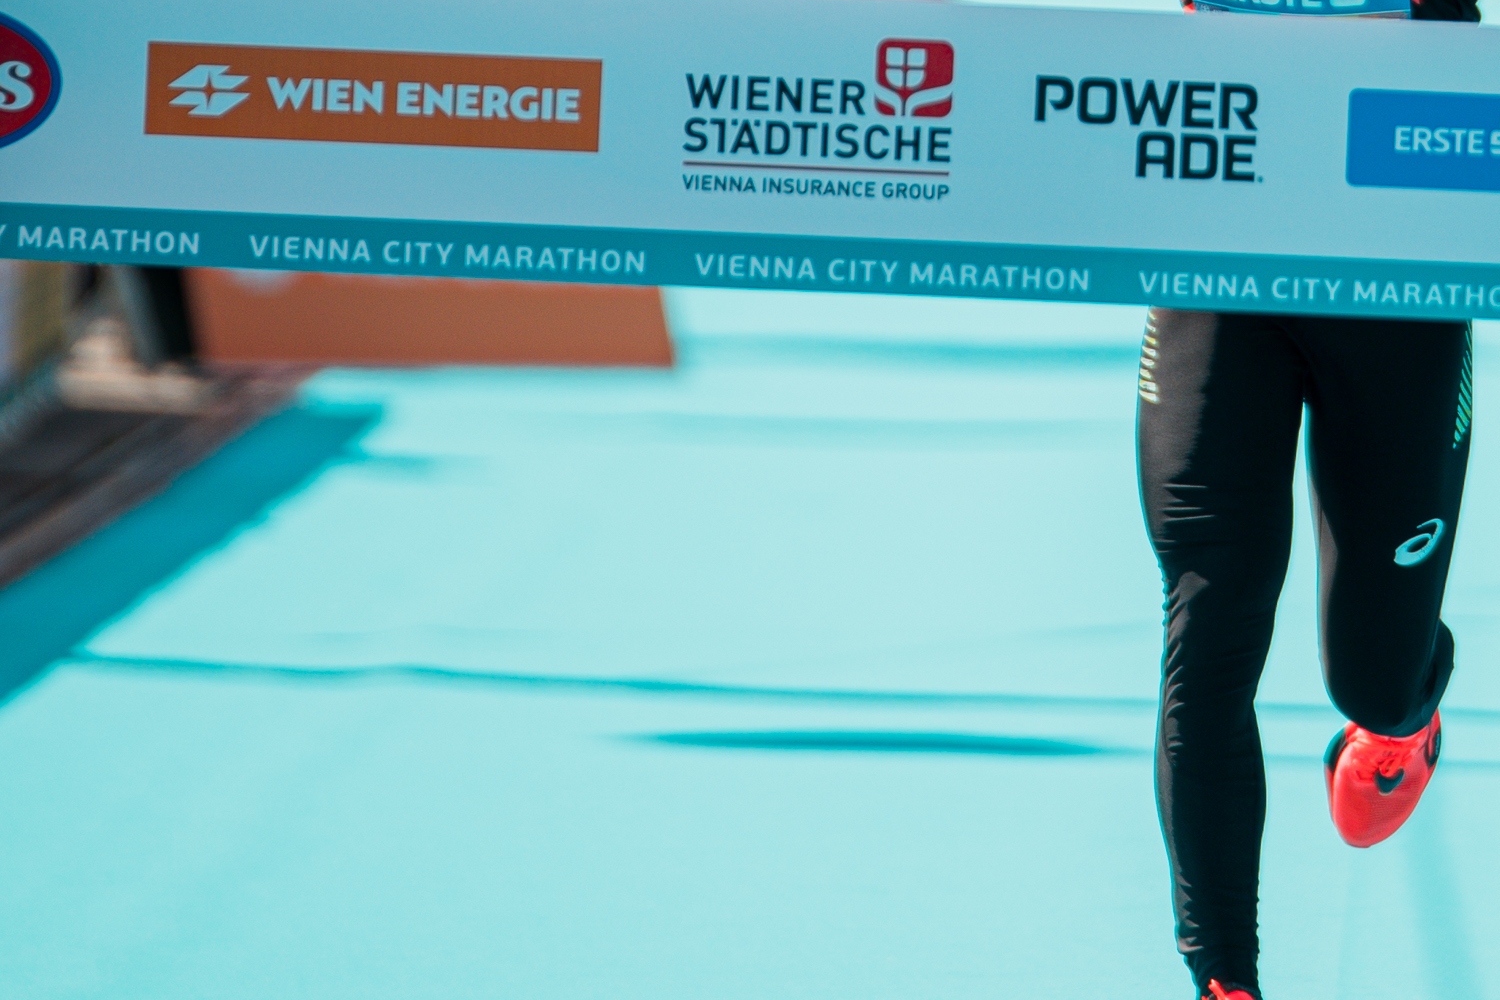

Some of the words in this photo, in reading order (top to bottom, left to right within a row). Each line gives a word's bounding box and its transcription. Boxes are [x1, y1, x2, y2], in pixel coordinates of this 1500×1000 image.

[266, 76, 384, 114] WIEN
[396, 82, 580, 122] ENERGIE
[685, 73, 866, 116] WIENER
[1033, 74, 1260, 132] POWER
[682, 116, 953, 164] STÄDTISCHE
[1134, 131, 1258, 183] ADE
[1394, 126, 1484, 154] ERSTE
[682, 174, 757, 193] VIENNA
[762, 177, 876, 198] INSURANCE
[881, 182, 950, 201] GROUP
[18, 225, 200, 255] MARATHON
[250, 235, 371, 262] VIENNA
[383, 240, 454, 265] CITY
[466, 244, 645, 273] MARATHON
[695, 253, 816, 280] VIENNA
[828, 259, 898, 283] CITY
[910, 262, 1089, 291] MARATHON
[1139, 272, 1259, 298] VIENNA
[1271, 277, 1341, 301] CITY
